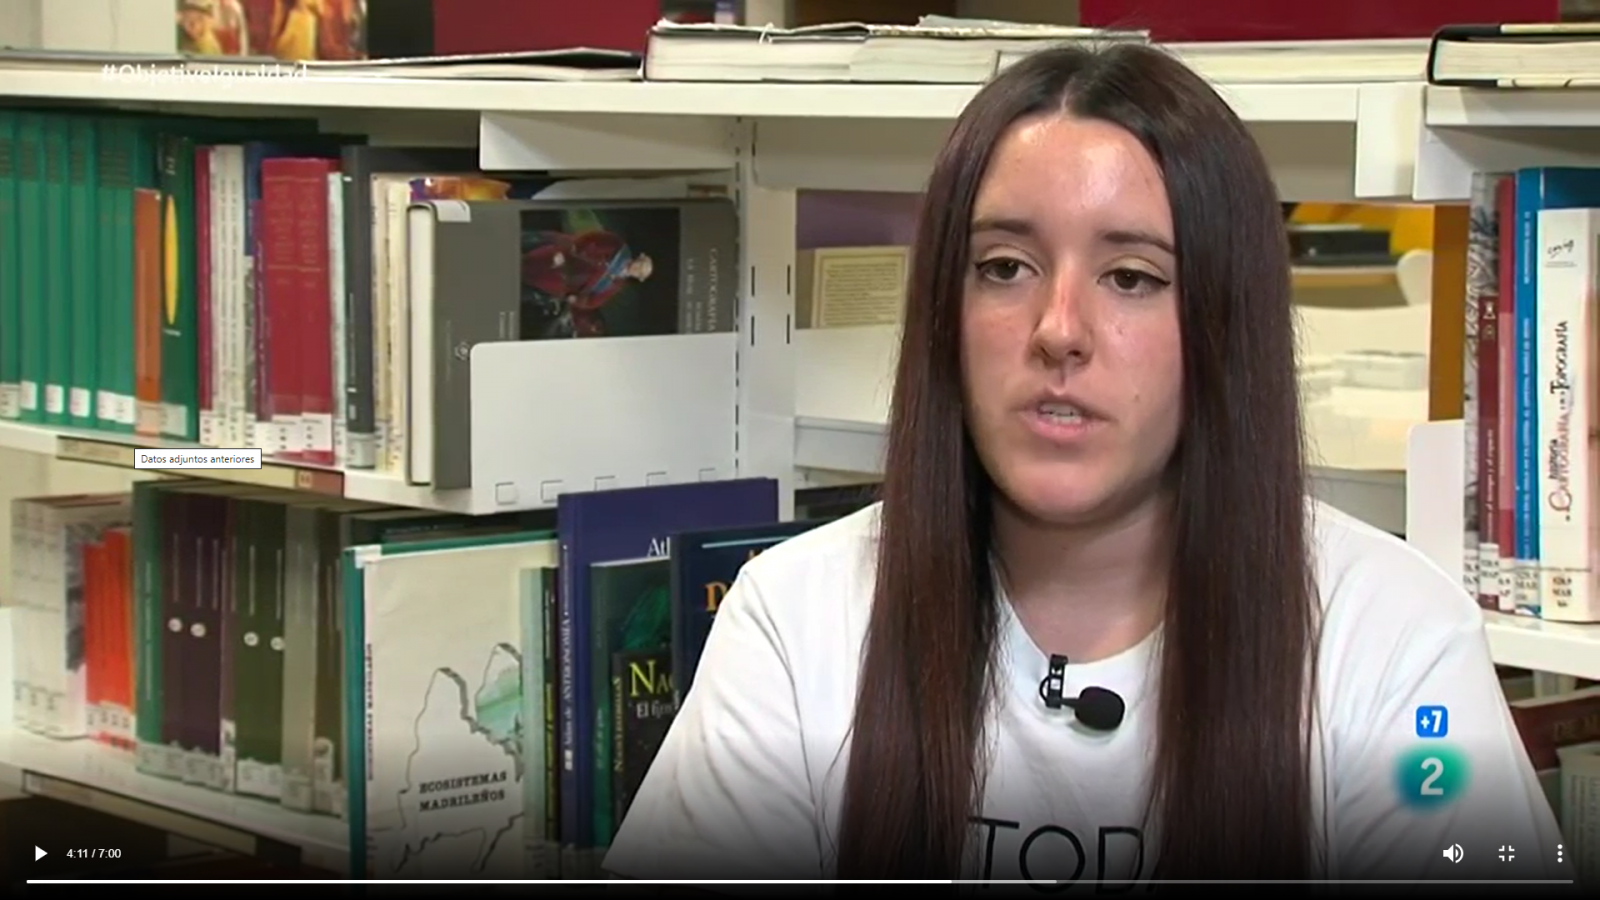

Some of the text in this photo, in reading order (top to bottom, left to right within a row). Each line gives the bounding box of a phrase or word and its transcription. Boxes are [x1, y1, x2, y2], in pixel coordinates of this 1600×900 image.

[419, 771, 507, 794] ECOSISTEMAS
[419, 788, 505, 812] MADRILEÑOS
[966, 815, 1160, 894] TOD
